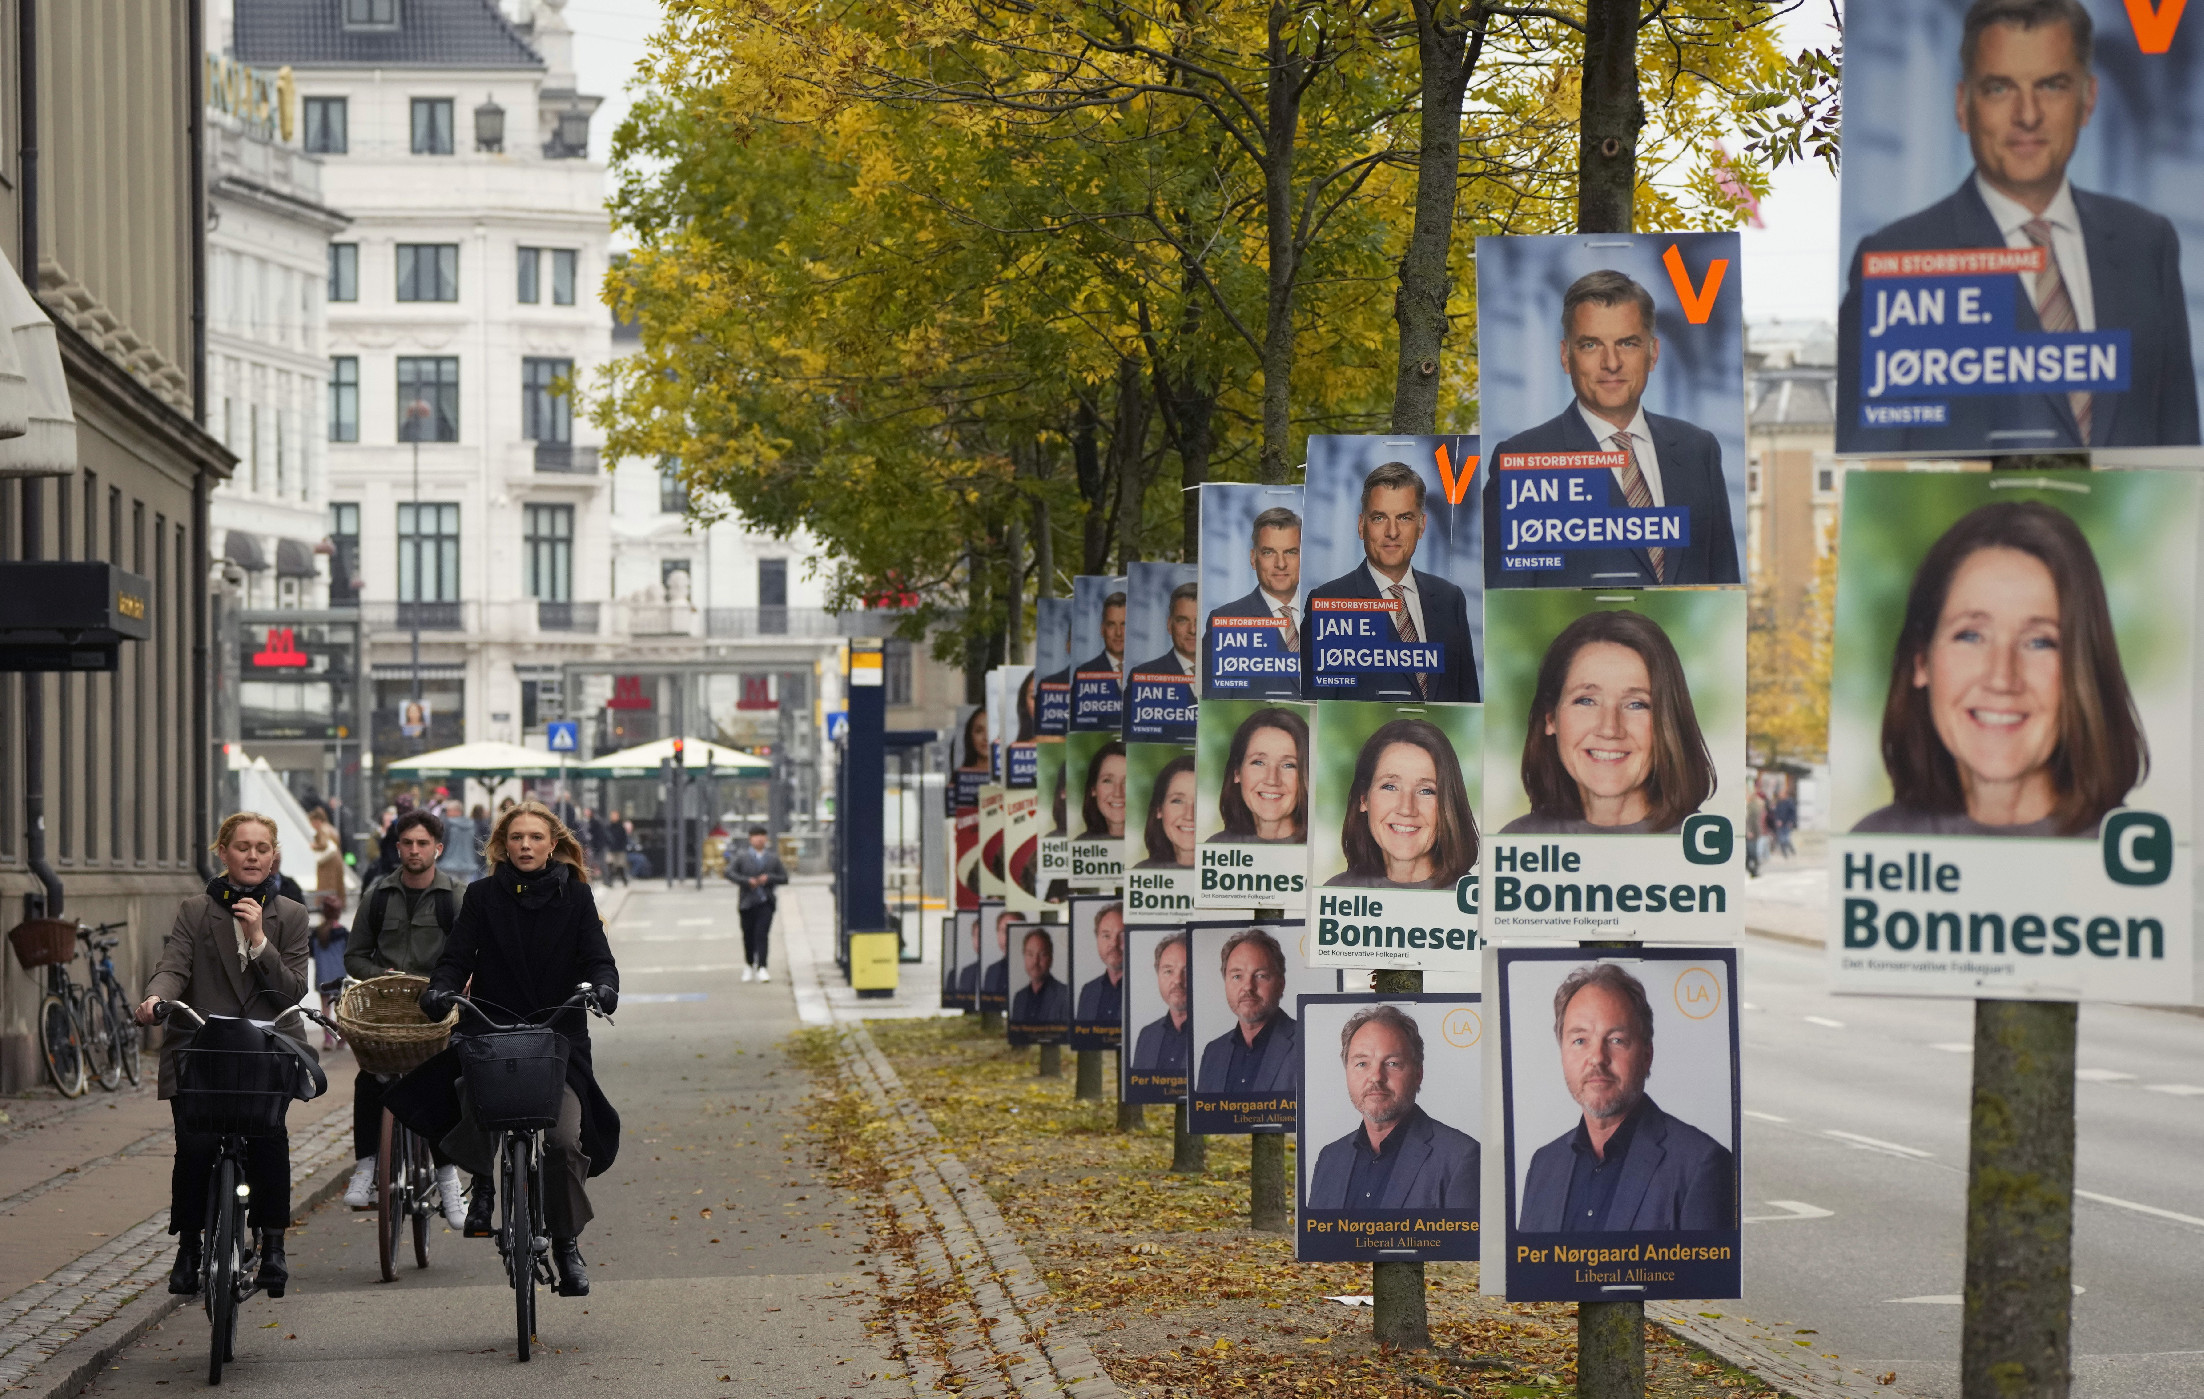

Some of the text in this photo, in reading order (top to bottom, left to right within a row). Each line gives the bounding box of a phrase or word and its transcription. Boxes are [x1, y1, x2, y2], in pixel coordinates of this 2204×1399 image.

[1868, 251, 2041, 274] DIN STORBYSTEMME
[1662, 244, 1730, 325] V
[1869, 287, 1992, 337] JAN E.
[1868, 344, 2117, 398] JØRGENSEN
[1865, 405, 1946, 424] VENSTRE
[1504, 454, 1625, 467] DIN STORBYSTEMME
[1435, 444, 1480, 504] V
[1506, 477, 1593, 510] JAN E.
[1507, 516, 1681, 551] JØRGENSEN
[1505, 556, 1562, 568] VENSTRE
[1314, 601, 1399, 610] DIN STORBYSTEMME
[1317, 618, 1376, 640] JAN E.
[1216, 632, 1268, 652] JAN E.
[1216, 656, 1300, 676] JØRGENS
[1317, 649, 1438, 671] JØRGENSEN
[1077, 683, 1098, 696] JAN
[1101, 683, 1110, 694] E.
[1316, 676, 1356, 686] VENSTRE
[1135, 687, 1179, 702] JAN E.
[1077, 700, 1122, 715] JØRGEN
[1072, 845, 1108, 857] Helle
[1202, 850, 1253, 867] Helle
[1495, 844, 1581, 873] Helle
[1042, 854, 1068, 868] Bo
[1072, 860, 1124, 875] Bonn
[1129, 874, 1174, 889] Helle
[1201, 868, 1306, 894] Bonnes
[1844, 852, 1961, 893] Helle
[1129, 890, 1194, 909] Bonn
[1494, 876, 1726, 913] Bonnesen
[1320, 896, 1383, 917] Helle
[1494, 917, 1619, 927] Det Konservative Folkeparti
[1843, 897, 2164, 960] Bonnesen
[1376, 951, 1409, 959] Folkeparti
[1687, 984, 1709, 1002] LA
[1453, 1021, 1472, 1035] LA
[1131, 1076, 1148, 1085] Per
[1195, 1101, 1216, 1112] Per
[1219, 1099, 1278, 1115] Nørgaard
[1234, 1114, 1264, 1124] Liberal
[1307, 1219, 1334, 1232] Per
[1338, 1218, 1410, 1236] Nørgaard
[1355, 1237, 1441, 1249] Liberal Alliance
[1517, 1243, 1731, 1267] Per Nørgaard Andersen
[1575, 1267, 1675, 1283] Liberal Alliance
